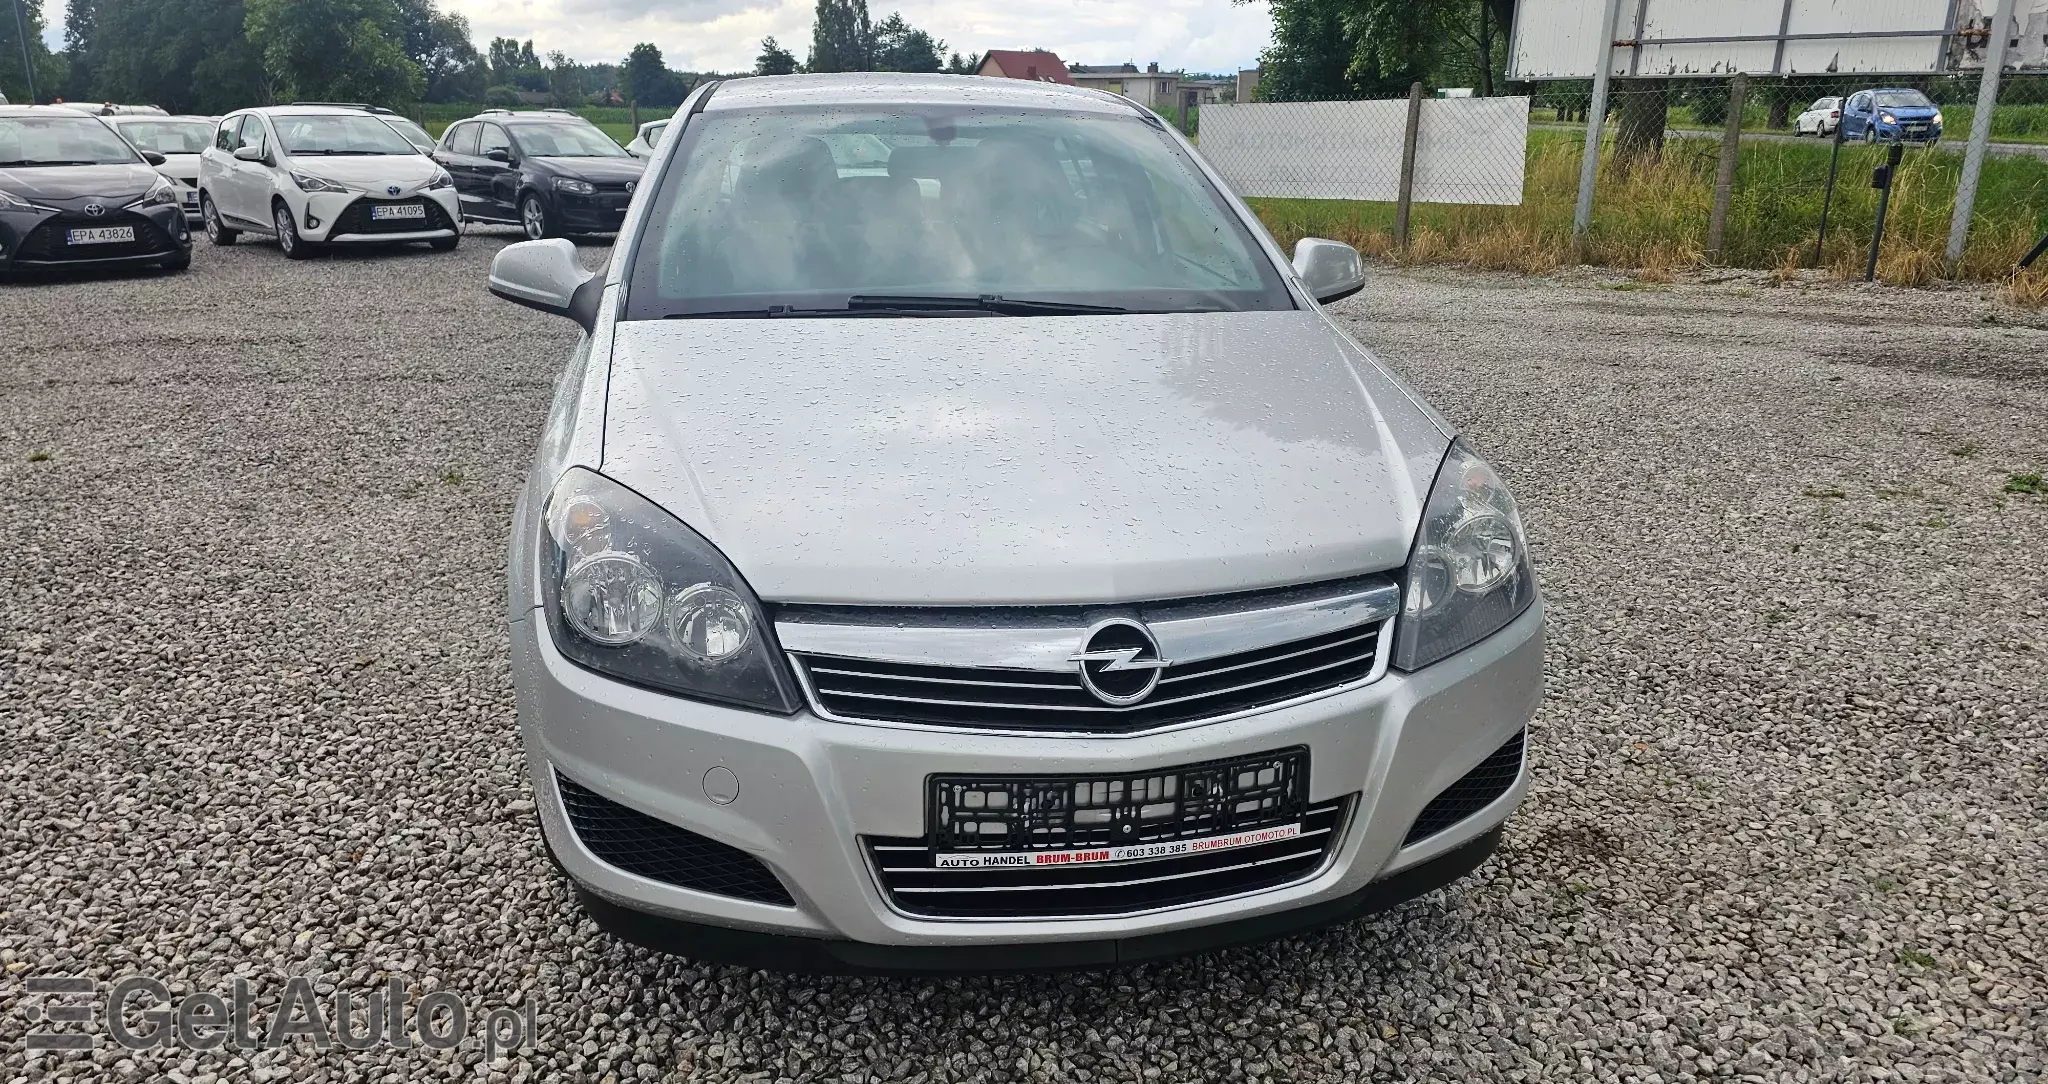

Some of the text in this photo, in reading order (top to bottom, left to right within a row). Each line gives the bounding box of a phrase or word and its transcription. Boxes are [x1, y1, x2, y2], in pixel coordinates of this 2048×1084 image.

[376, 205, 424, 217] EPA 41095
[72, 227, 133, 241] EPA 43826
[940, 858, 980, 867] AUTO
[983, 856, 1030, 866] HANDEL
[1036, 850, 1110, 864] BRUM-BRUM
[1126, 849, 1145, 858] 603
[1147, 846, 1166, 856] 338
[1169, 843, 1187, 854] 385
